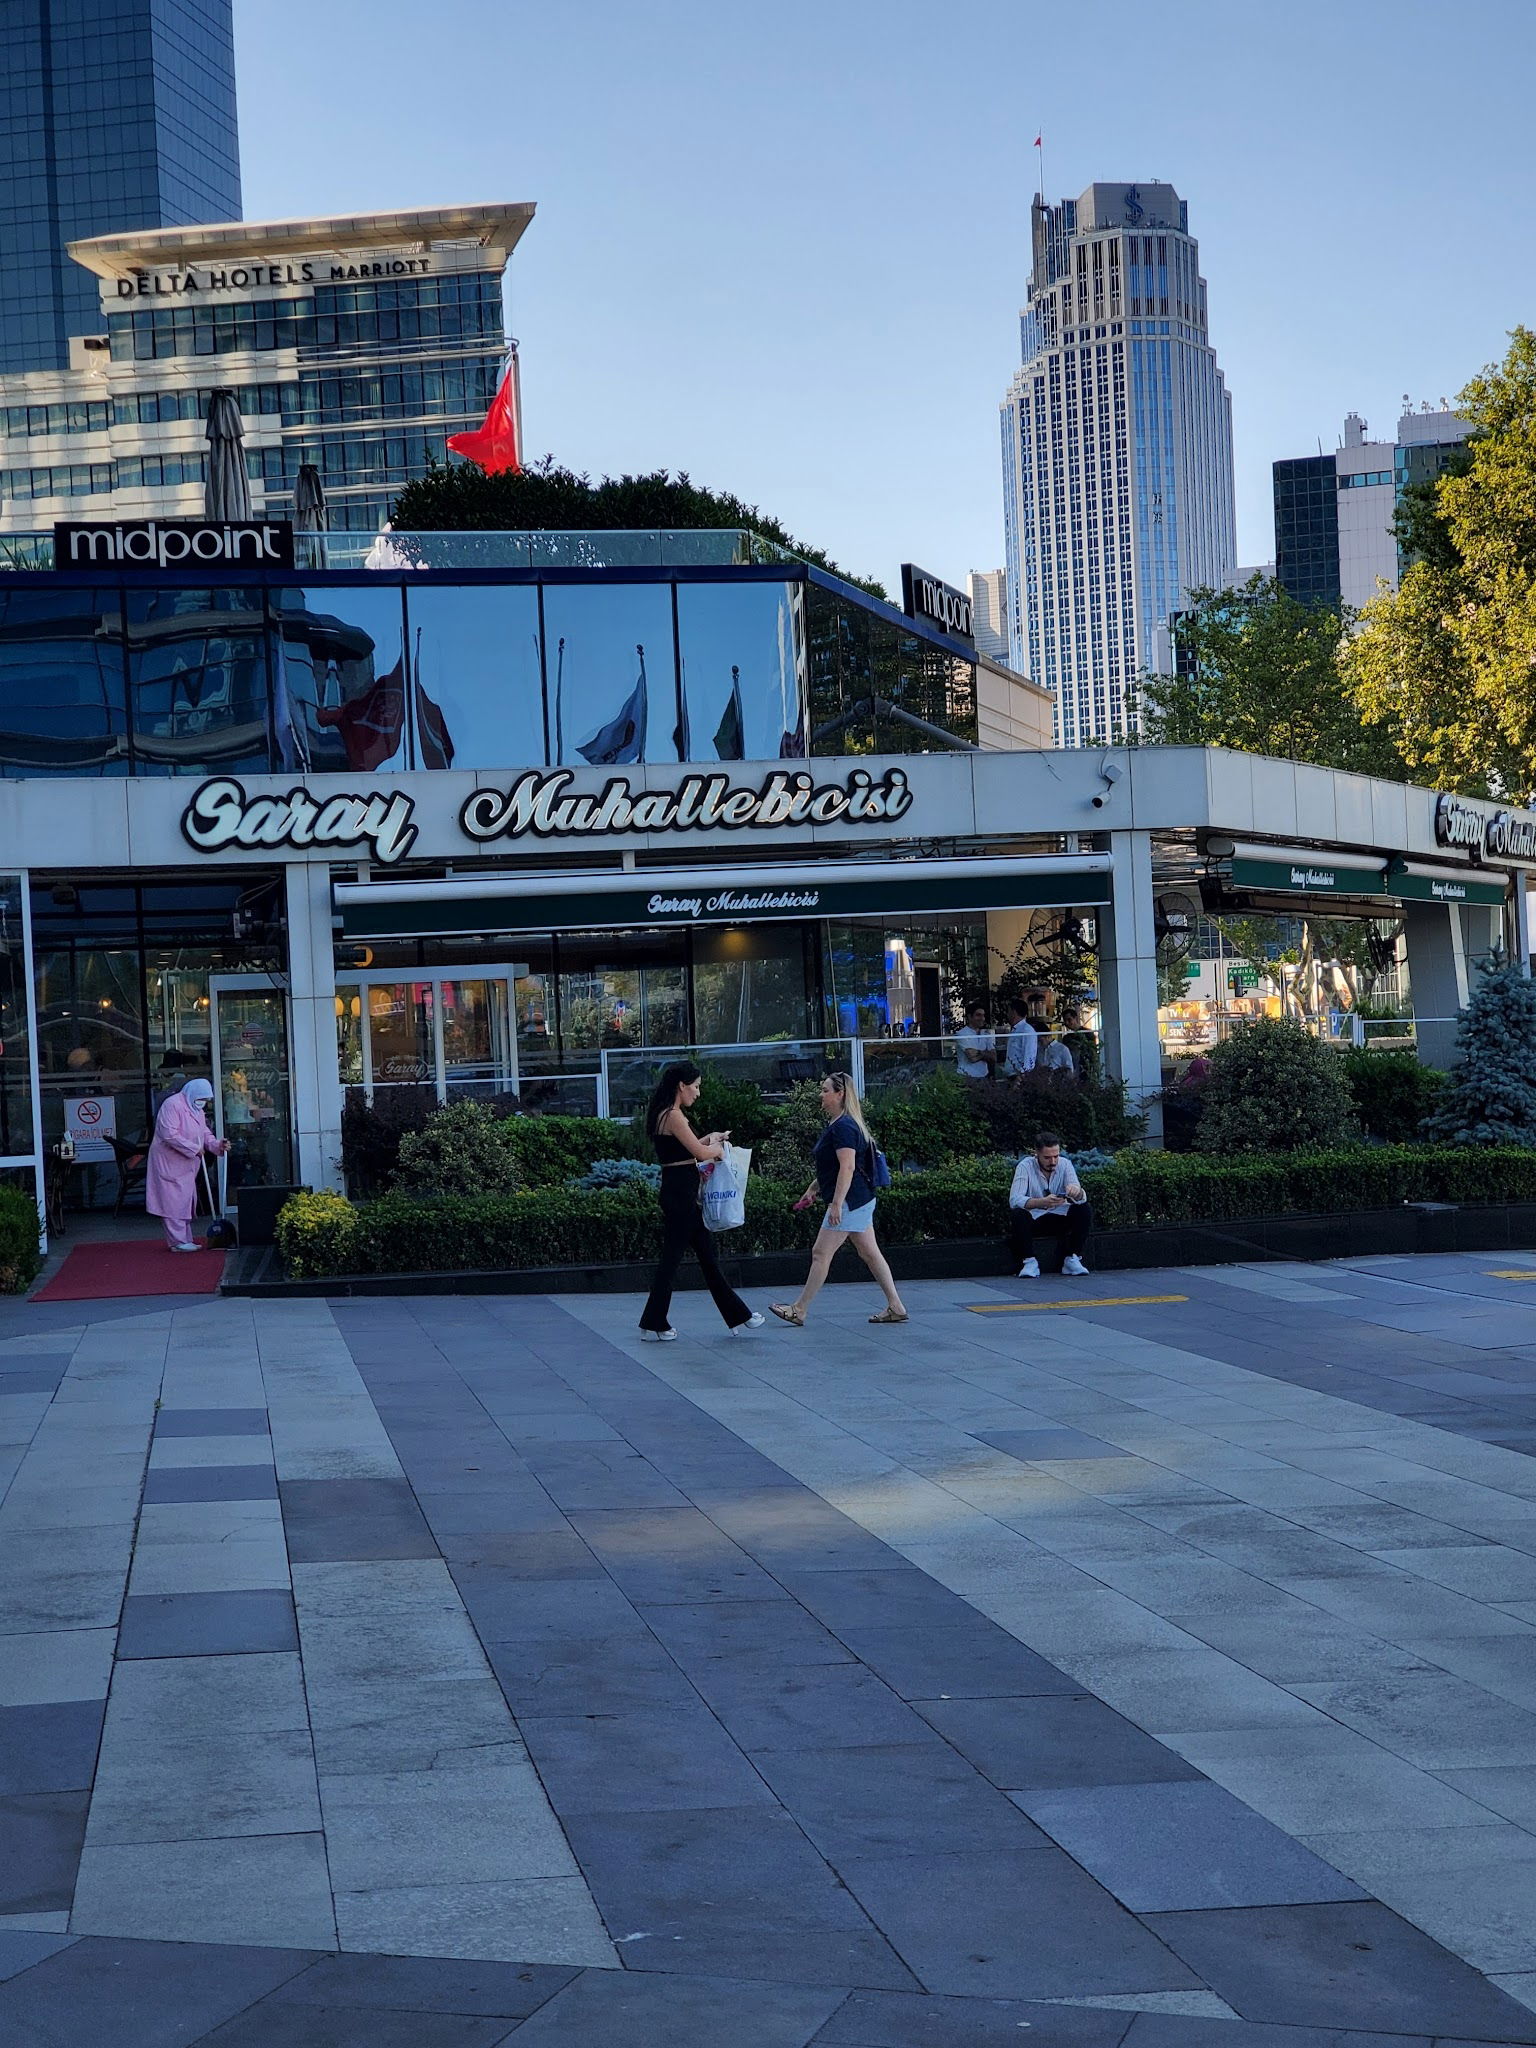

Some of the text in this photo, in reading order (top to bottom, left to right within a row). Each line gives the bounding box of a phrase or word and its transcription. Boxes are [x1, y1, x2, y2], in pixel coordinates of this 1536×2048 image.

[117, 258, 431, 298] DELTA HOTELS MARRIOTT
[70, 522, 282, 568] midpoint
[183, 768, 913, 864] Saray Muhallebicisi
[647, 890, 820, 918] Saray Muhallebicisi
